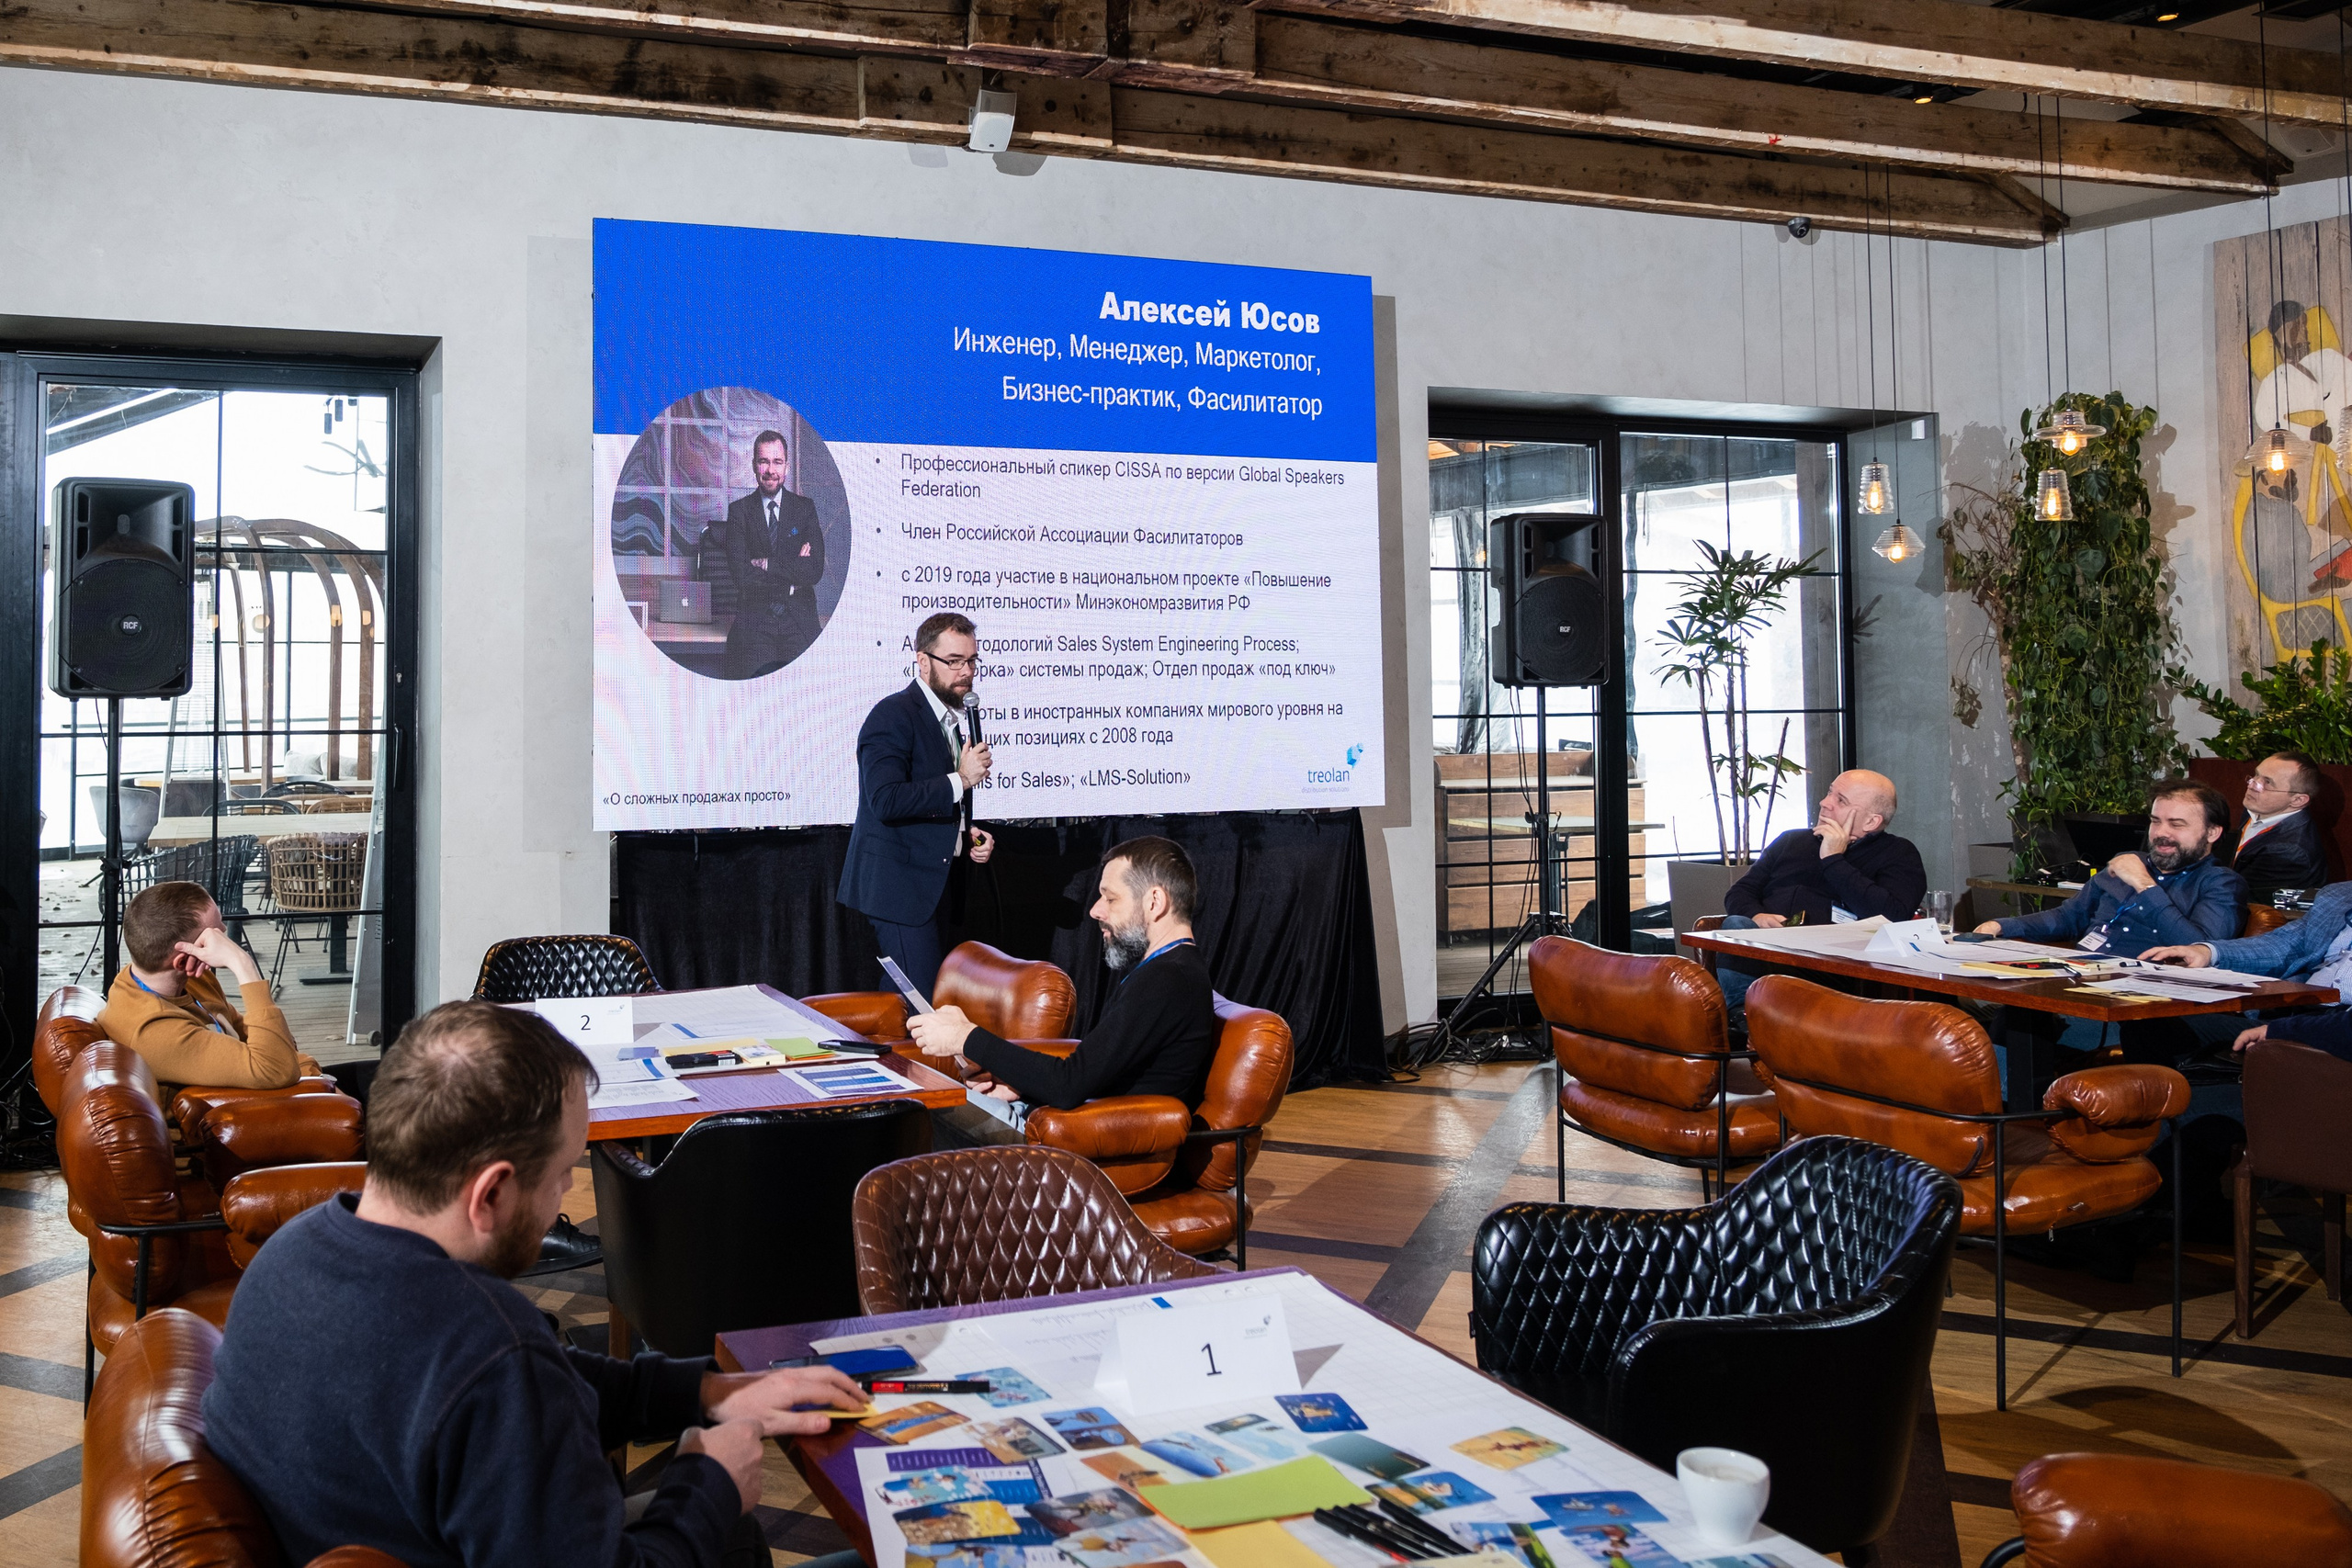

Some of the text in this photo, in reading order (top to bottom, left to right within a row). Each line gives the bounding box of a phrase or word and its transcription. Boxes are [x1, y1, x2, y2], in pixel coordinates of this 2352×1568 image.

[1100, 292, 1319, 333] Алексей Юсов
[955, 327, 1320, 375] Инженер, Менеджер, Маркетолог,
[1003, 376, 1322, 420] Бизнес-практик, Фасилитатор
[901, 454, 1344, 487] Профессиональный спикер CISSA по версии Global Speakers
[902, 479, 980, 497] Federation
[902, 523, 1243, 549] Член Российской Ассоциации Фасилитаторов
[902, 566, 1331, 590] с 2019 года участие в национальном проекте «Повышение
[902, 593, 1250, 614] производительности» Минэкономразвития РФ
[976, 636, 1298, 656] тодологий Sales System Engineering Process;
[1020, 665, 1083, 677] системы
[1089, 664, 1148, 681] продаж;
[1153, 660, 1197, 679] Отдел
[1203, 664, 1254, 680] продаж
[1260, 664, 1292, 678] «под
[1295, 664, 1335, 675] ключ»
[1012, 707, 1019, 719] в
[1024, 706, 1121, 723] иностранных
[1126, 705, 1203, 717] компаниях
[1208, 705, 1273, 721] мирового
[1277, 704, 1323, 720] уровня
[1329, 704, 1342, 715] на
[1016, 732, 1085, 747] позициях
[1090, 732, 1098, 743] с
[1102, 728, 1136, 743] 2008
[1142, 730, 1172, 745] года
[998, 773, 1016, 788] for
[1022, 772, 1074, 788] Sales»;
[1080, 769, 1190, 786] «LMS-Solution»
[1307, 767, 1351, 784] treolan
[603, 792, 790, 806] «О сложных продажах просто»
[581, 1014, 592, 1031] 2
[1201, 1342, 1222, 1376] 1
